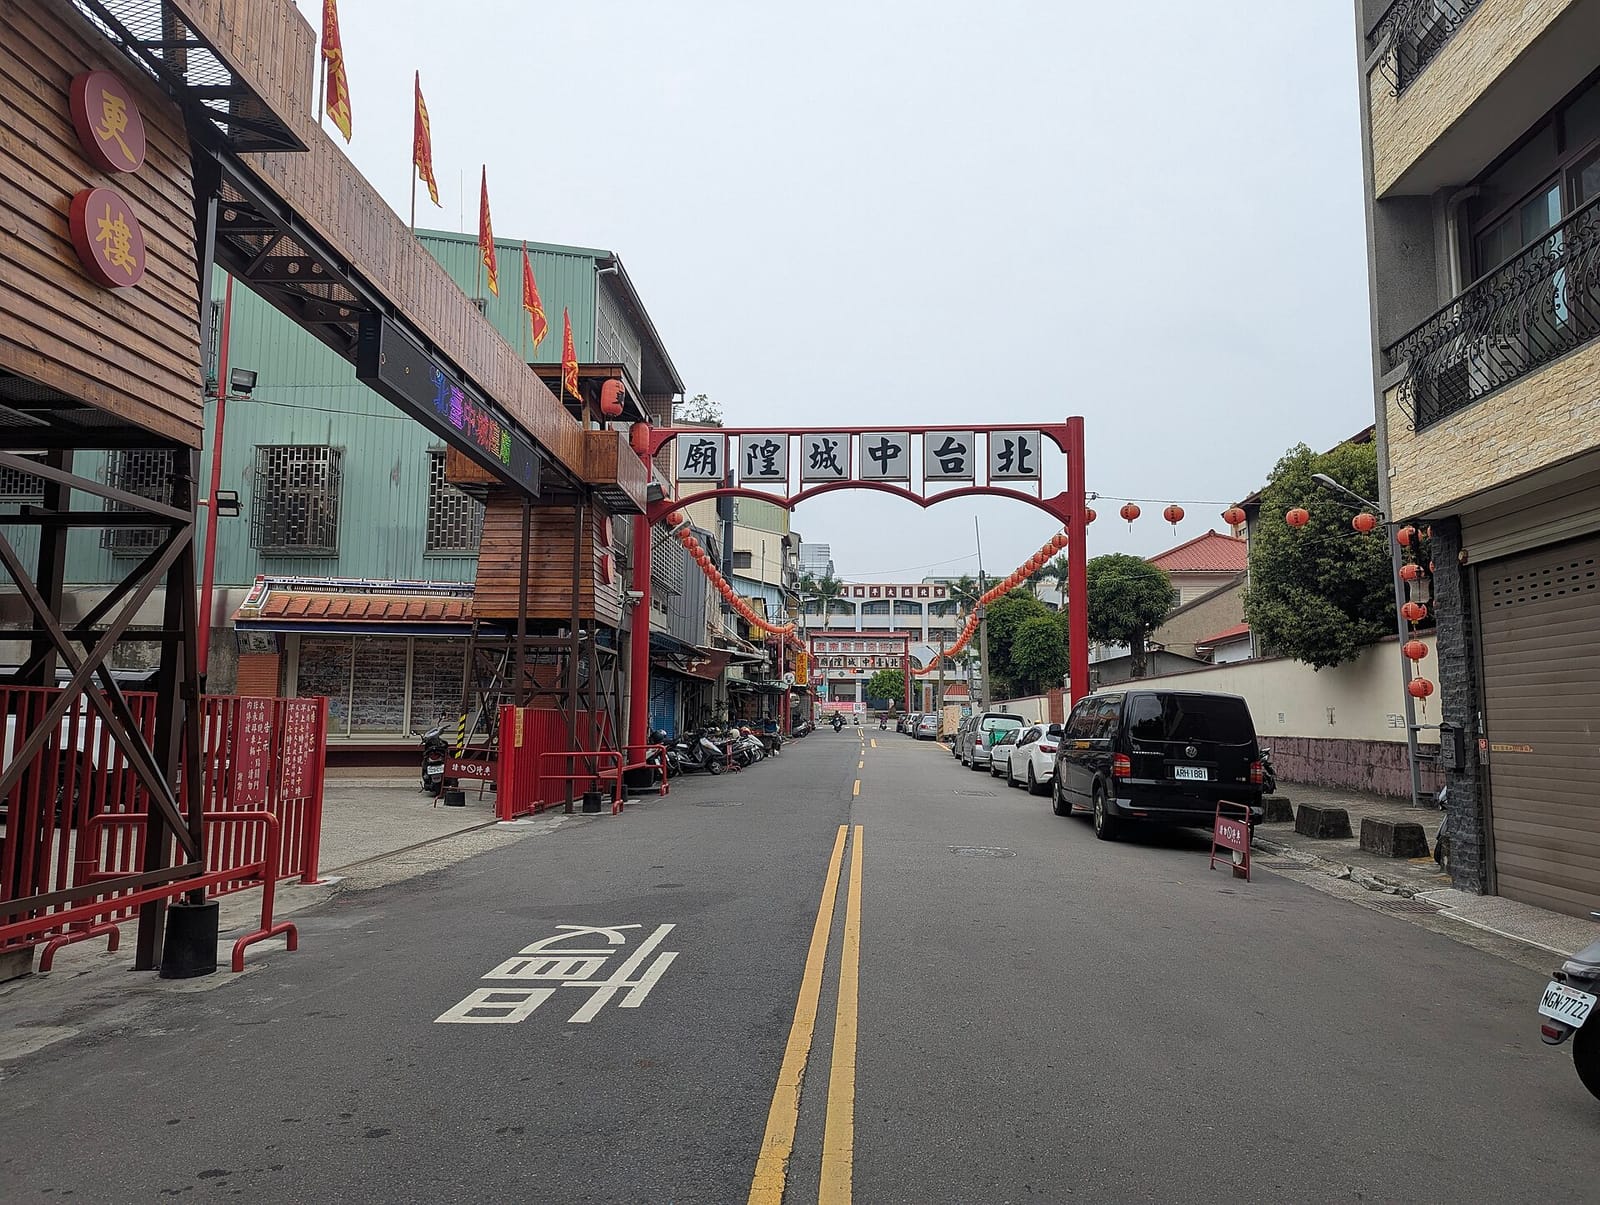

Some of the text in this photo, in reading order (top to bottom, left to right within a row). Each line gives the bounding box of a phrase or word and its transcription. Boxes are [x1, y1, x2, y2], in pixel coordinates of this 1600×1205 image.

[684, 437, 1034, 477] 北台中城隍廟
[1175, 769, 1207, 780] ARH-1881
[1541, 990, 1590, 1019] NGN-7722
